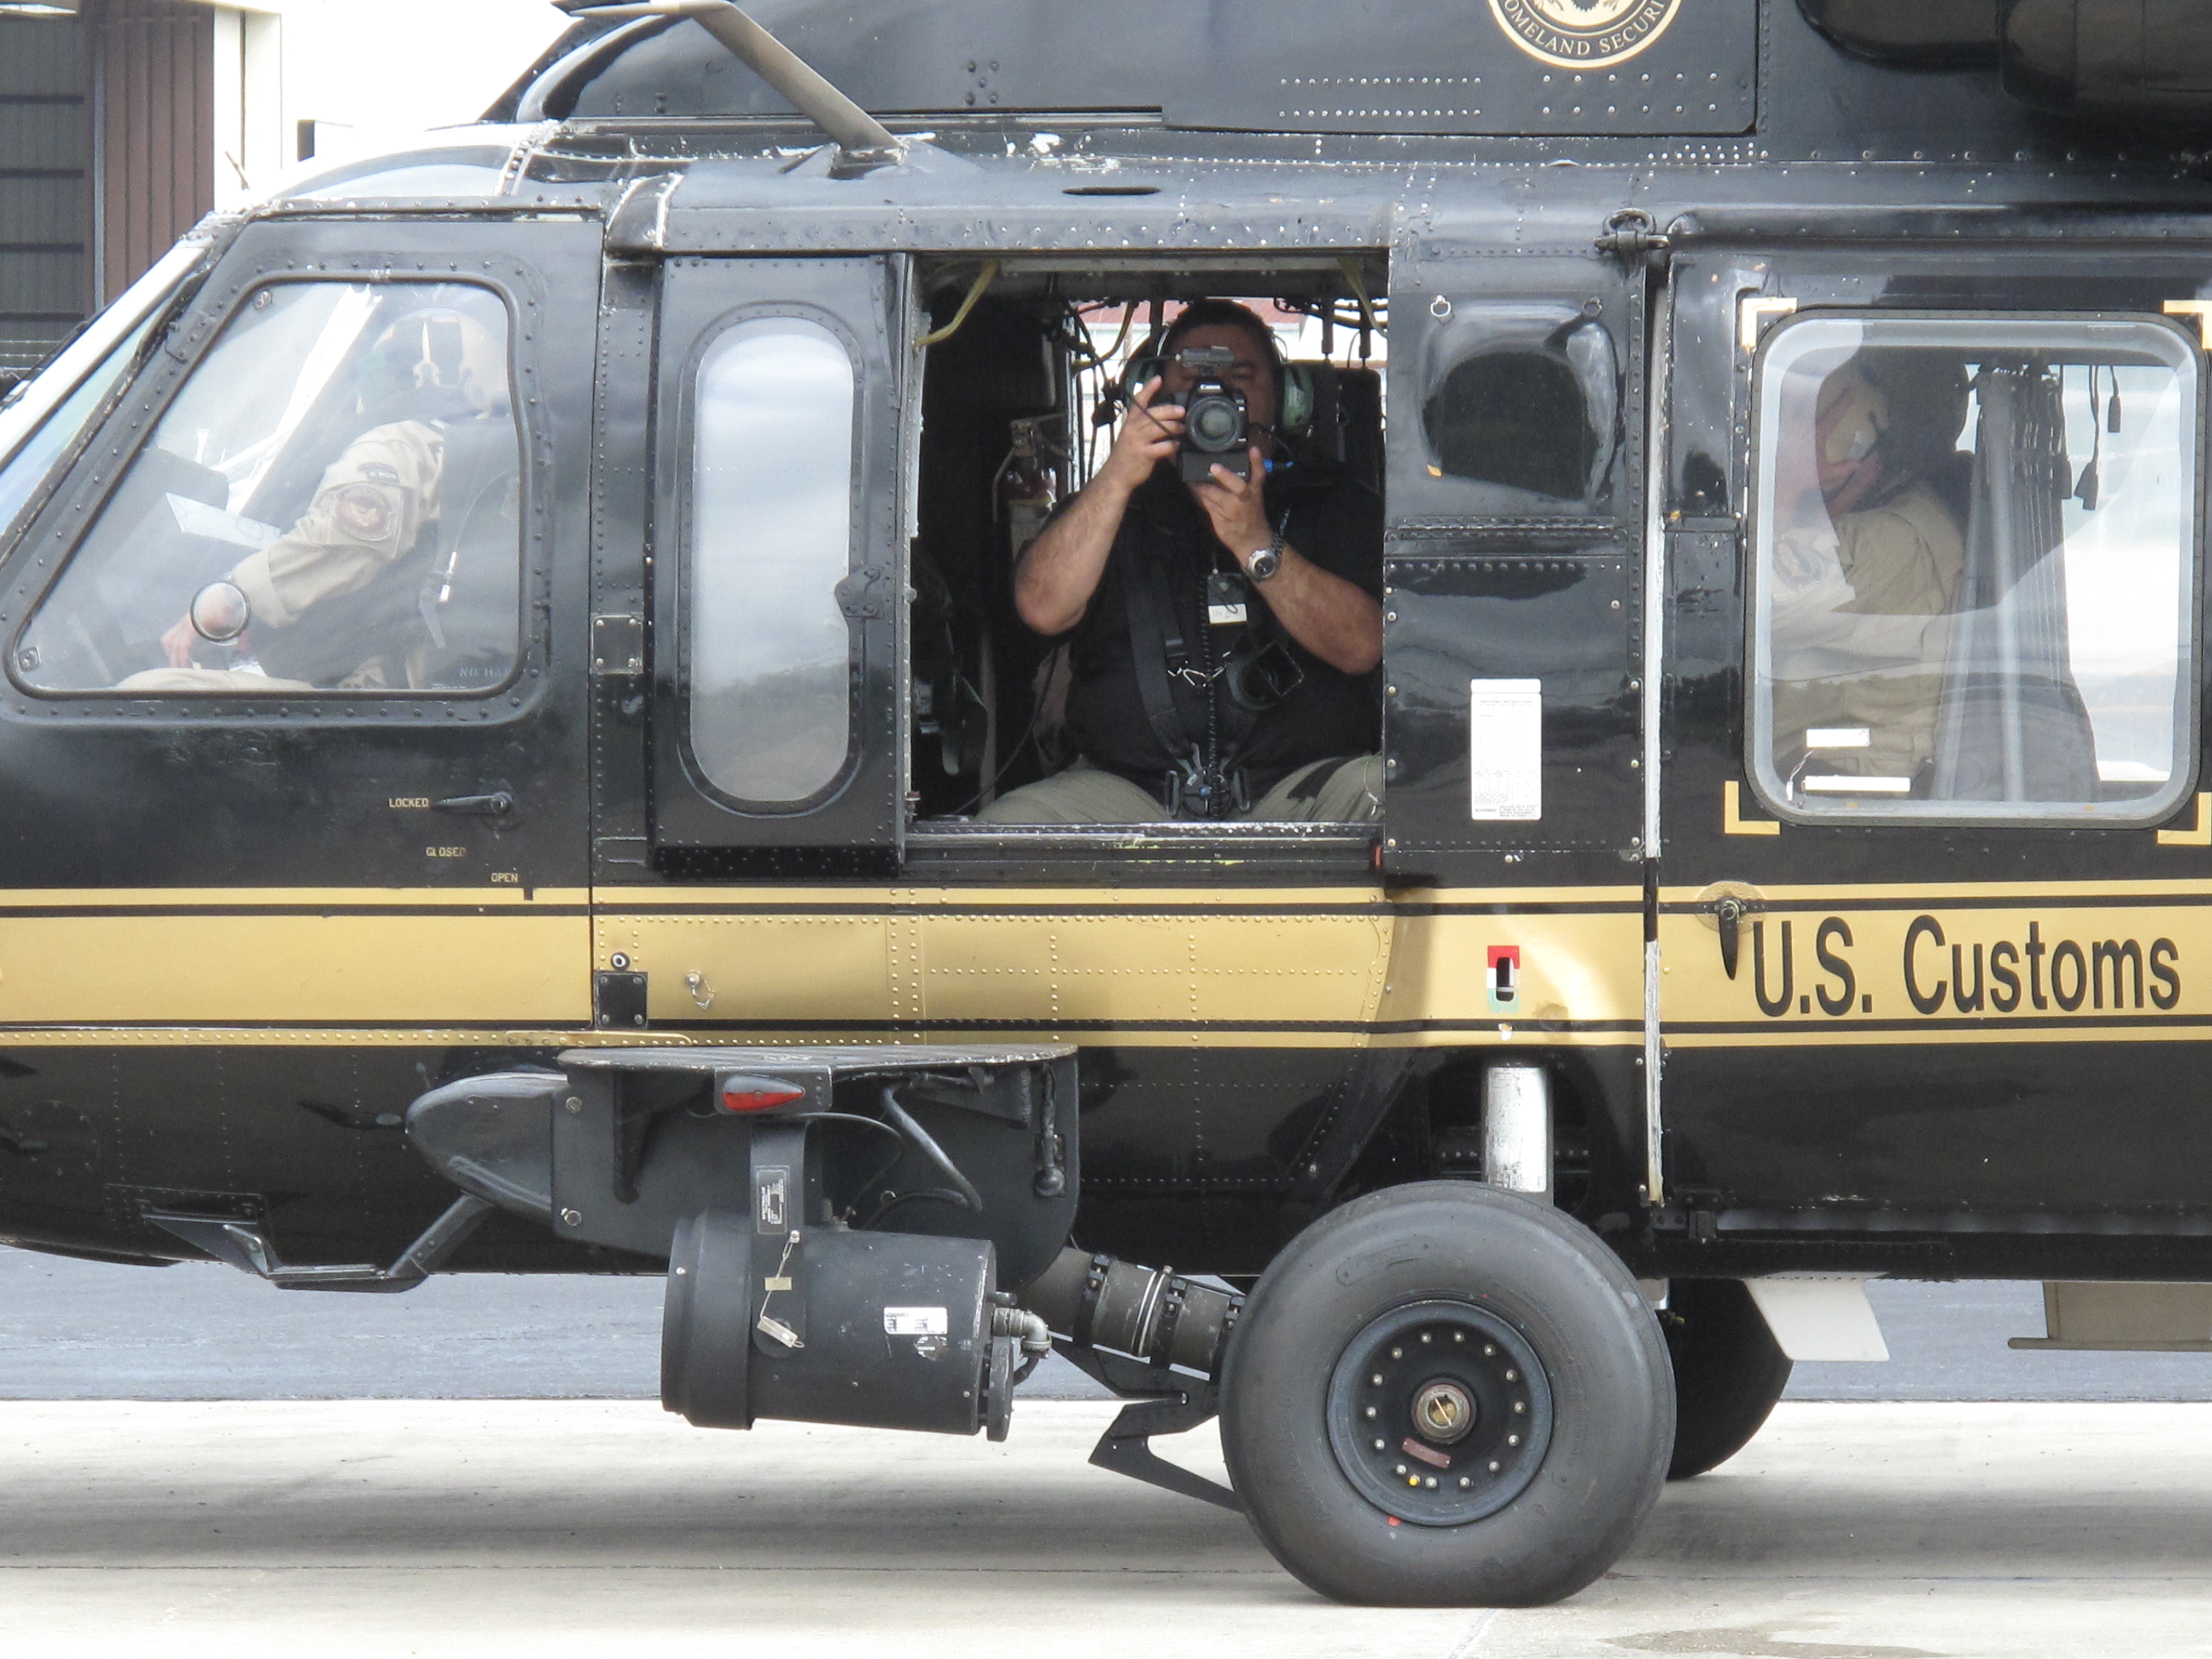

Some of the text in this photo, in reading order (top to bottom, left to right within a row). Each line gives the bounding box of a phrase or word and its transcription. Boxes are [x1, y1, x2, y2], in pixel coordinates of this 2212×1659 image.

[389, 797, 429, 808] LOCKED
[426, 847, 466, 857] CLOSED
[490, 872, 518, 883] OPEN
[1754, 916, 2180, 1017] U.S. Customs
